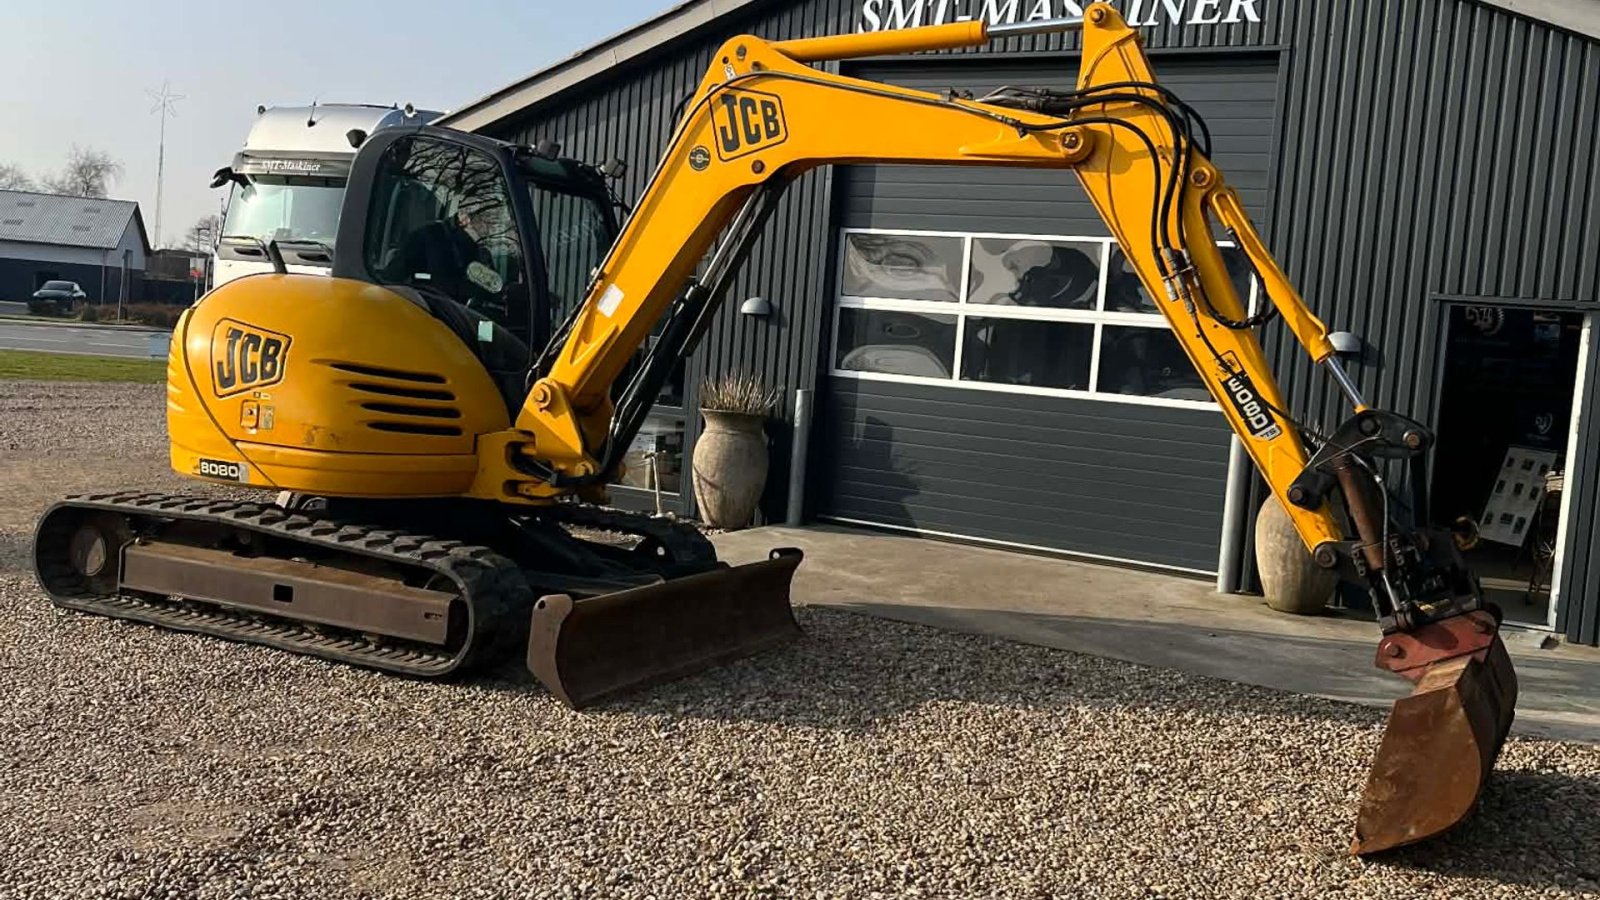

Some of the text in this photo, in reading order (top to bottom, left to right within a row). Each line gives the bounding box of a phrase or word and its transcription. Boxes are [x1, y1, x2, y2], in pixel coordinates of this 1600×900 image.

[720, 94, 780, 152] JCB
[217, 327, 281, 389] JCB
[201, 461, 239, 477] 8080
